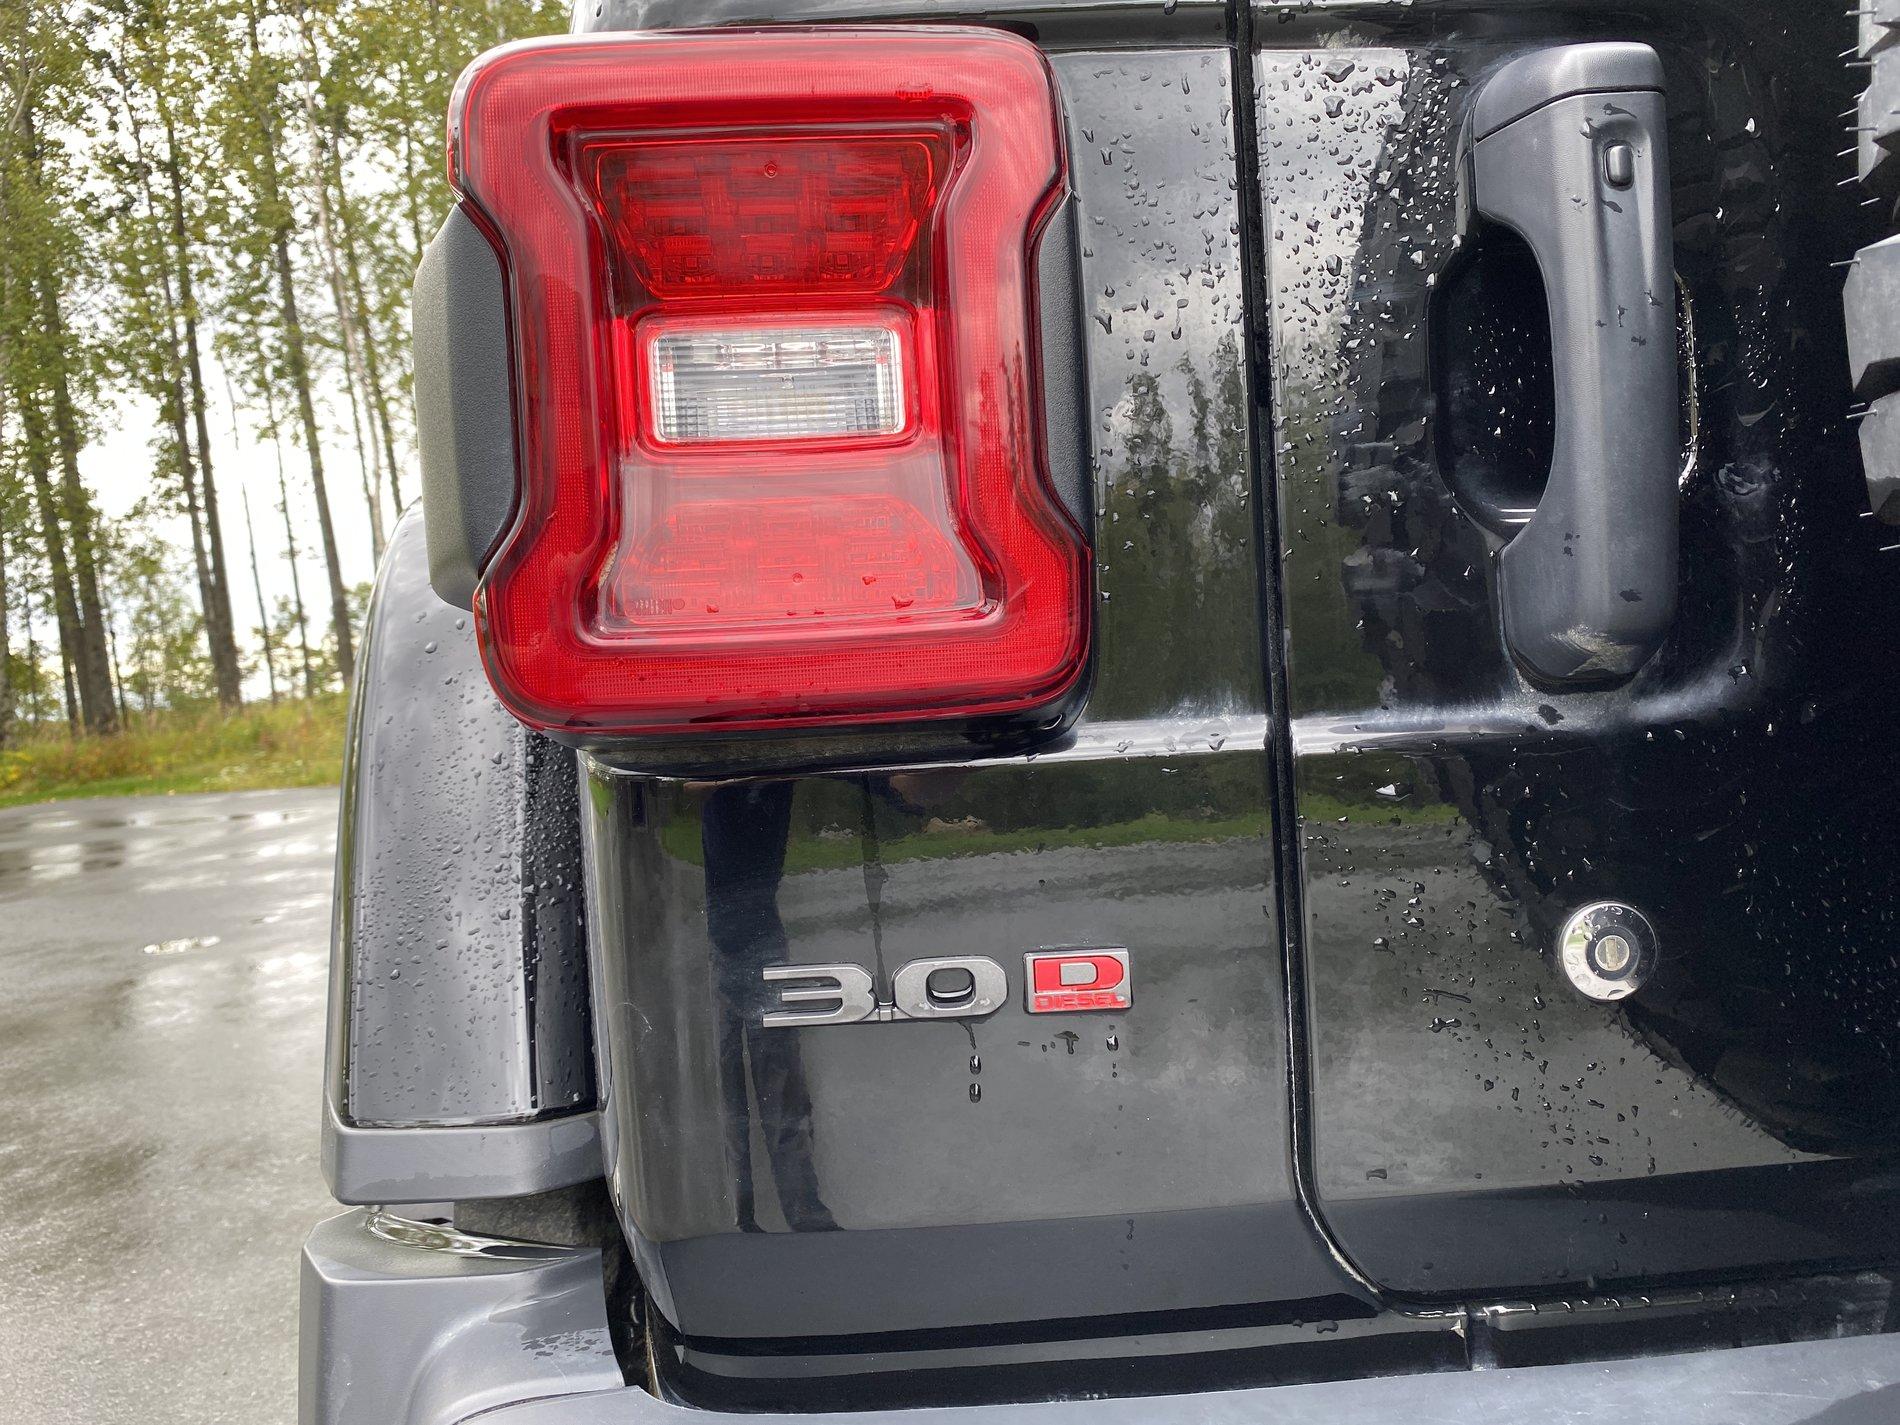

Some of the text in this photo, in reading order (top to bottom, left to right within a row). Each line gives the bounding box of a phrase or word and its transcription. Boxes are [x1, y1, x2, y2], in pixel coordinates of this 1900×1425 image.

[762, 954, 1124, 1028] 3.0 D
[1034, 992, 1127, 1011] DIESEL
